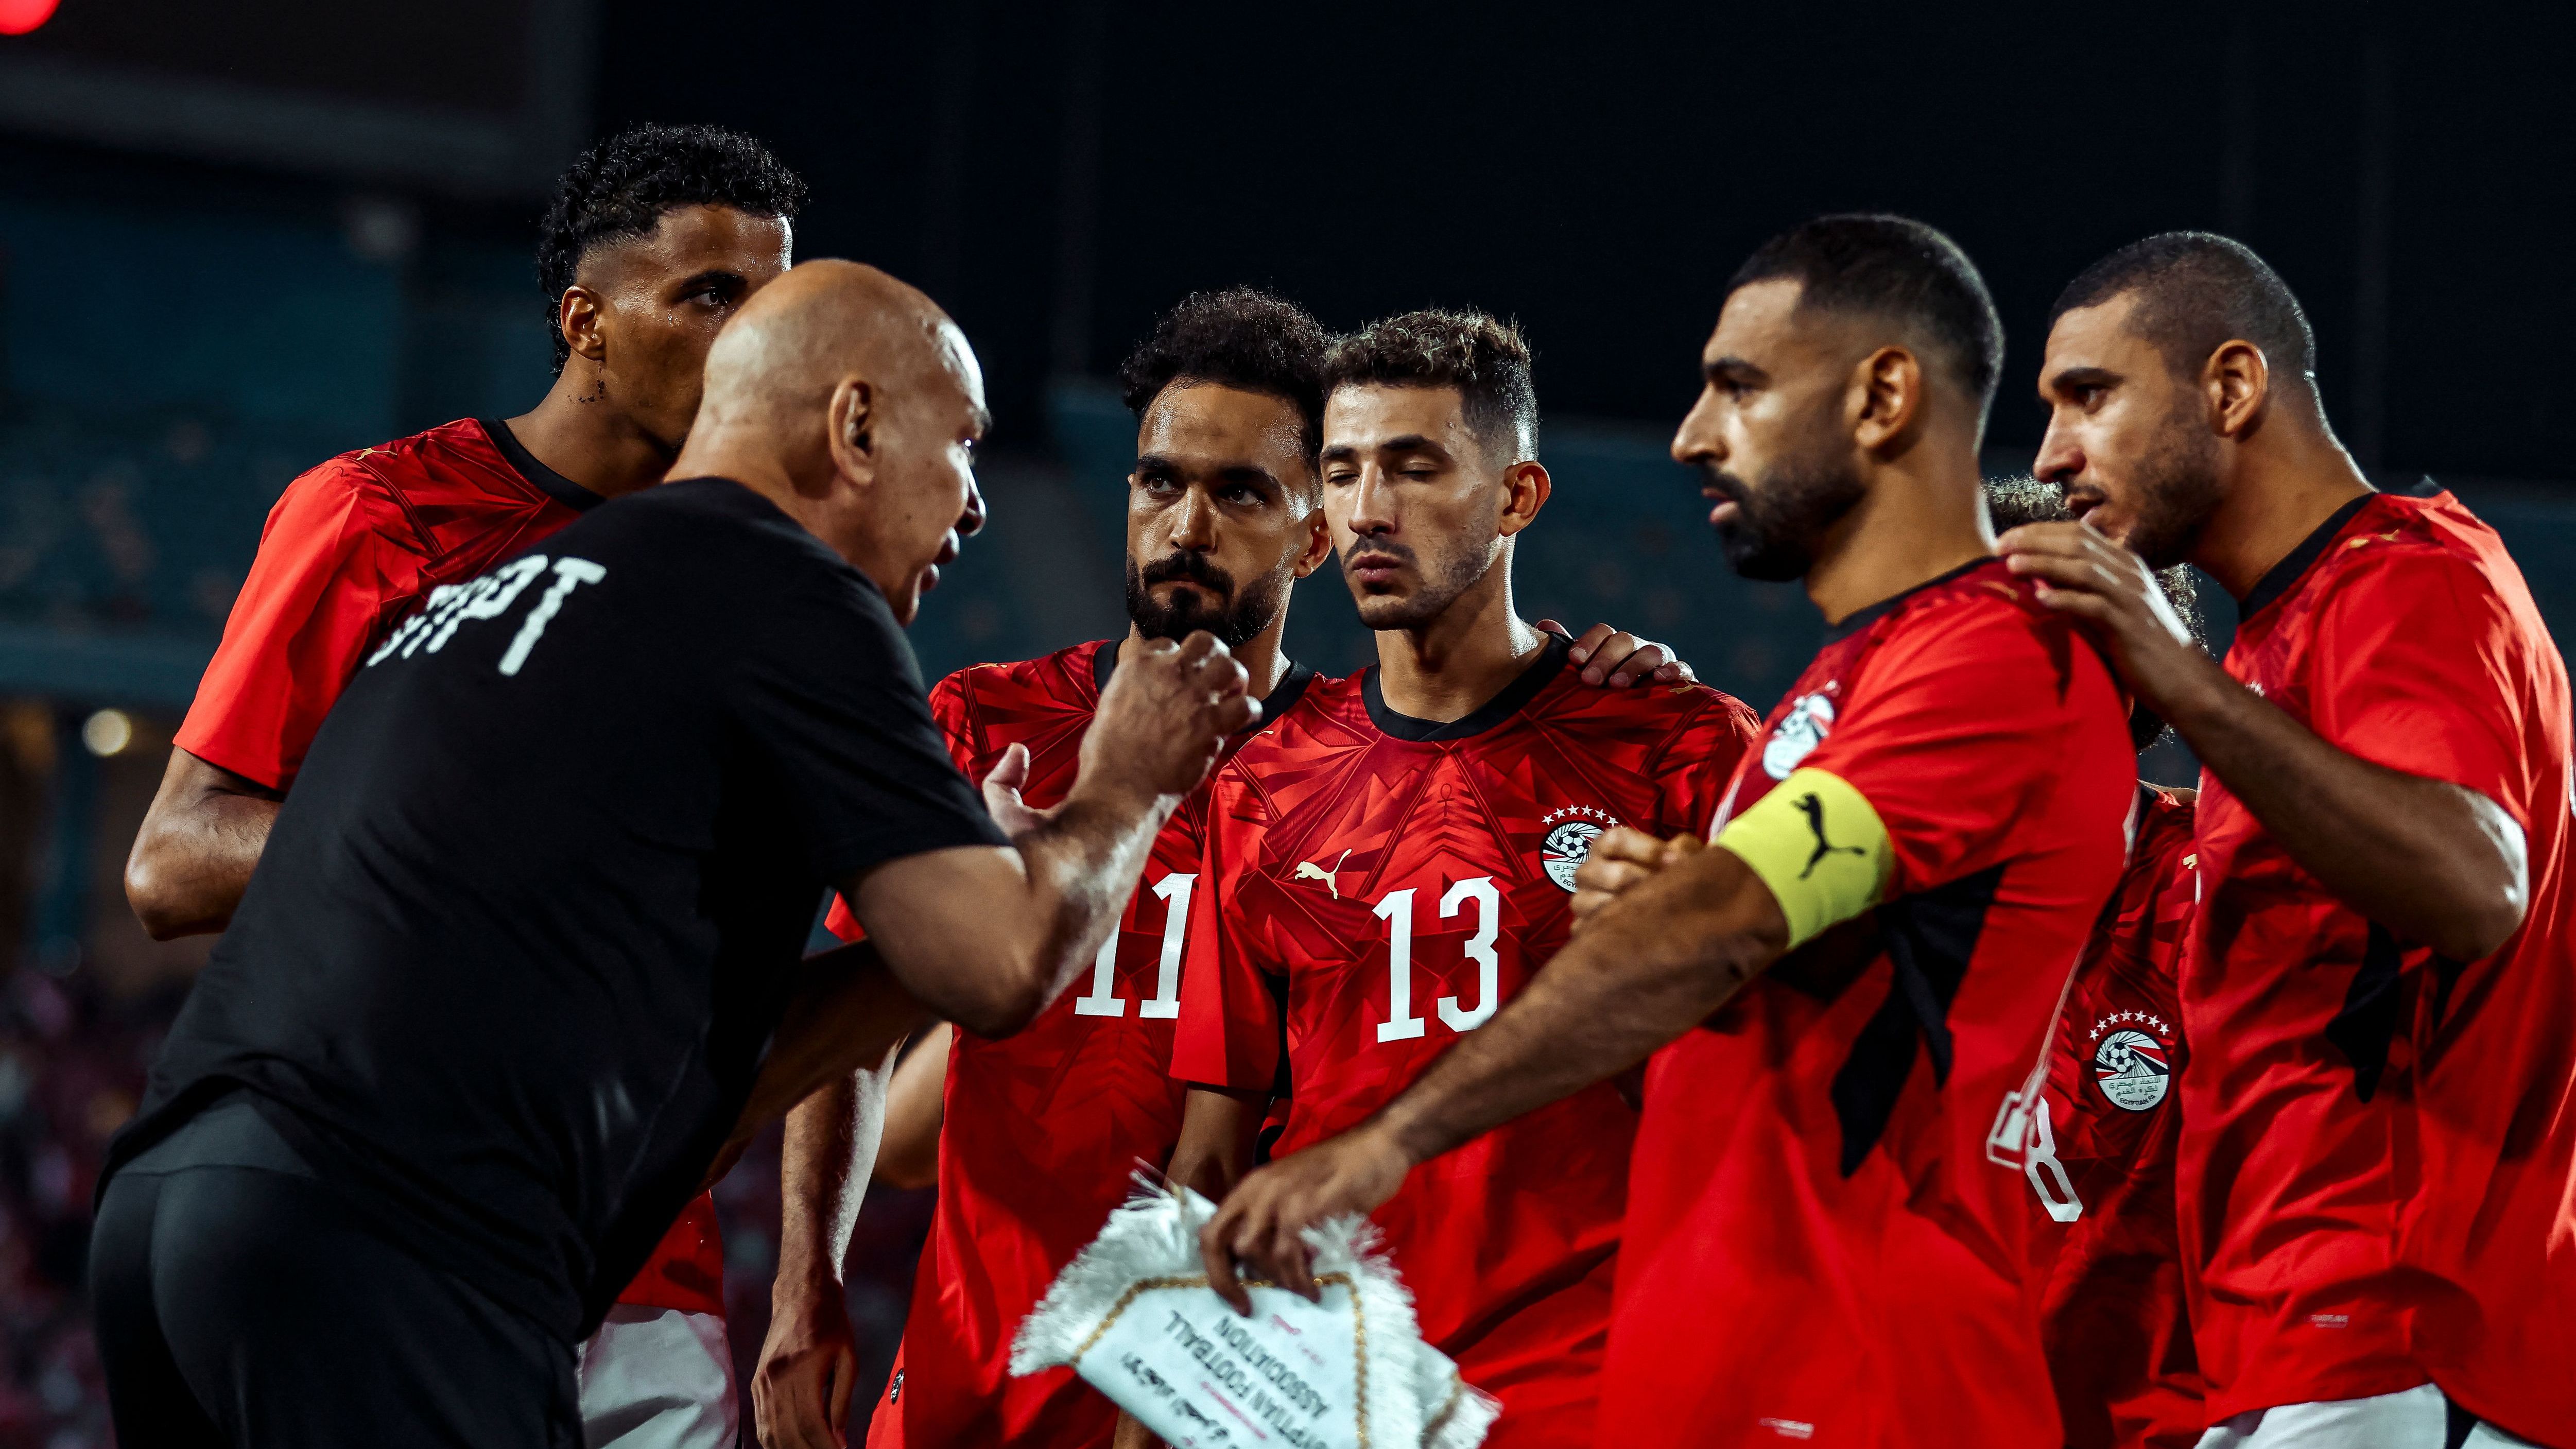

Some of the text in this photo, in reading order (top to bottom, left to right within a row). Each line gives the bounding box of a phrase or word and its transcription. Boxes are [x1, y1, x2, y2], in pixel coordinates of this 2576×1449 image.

[1075, 873, 1199, 1019] 11
[1372, 875, 1500, 1043] 13
[1163, 1309, 1256, 1400] FOOTBALL
[1213, 1315, 1330, 1420] ASSOCIATION
